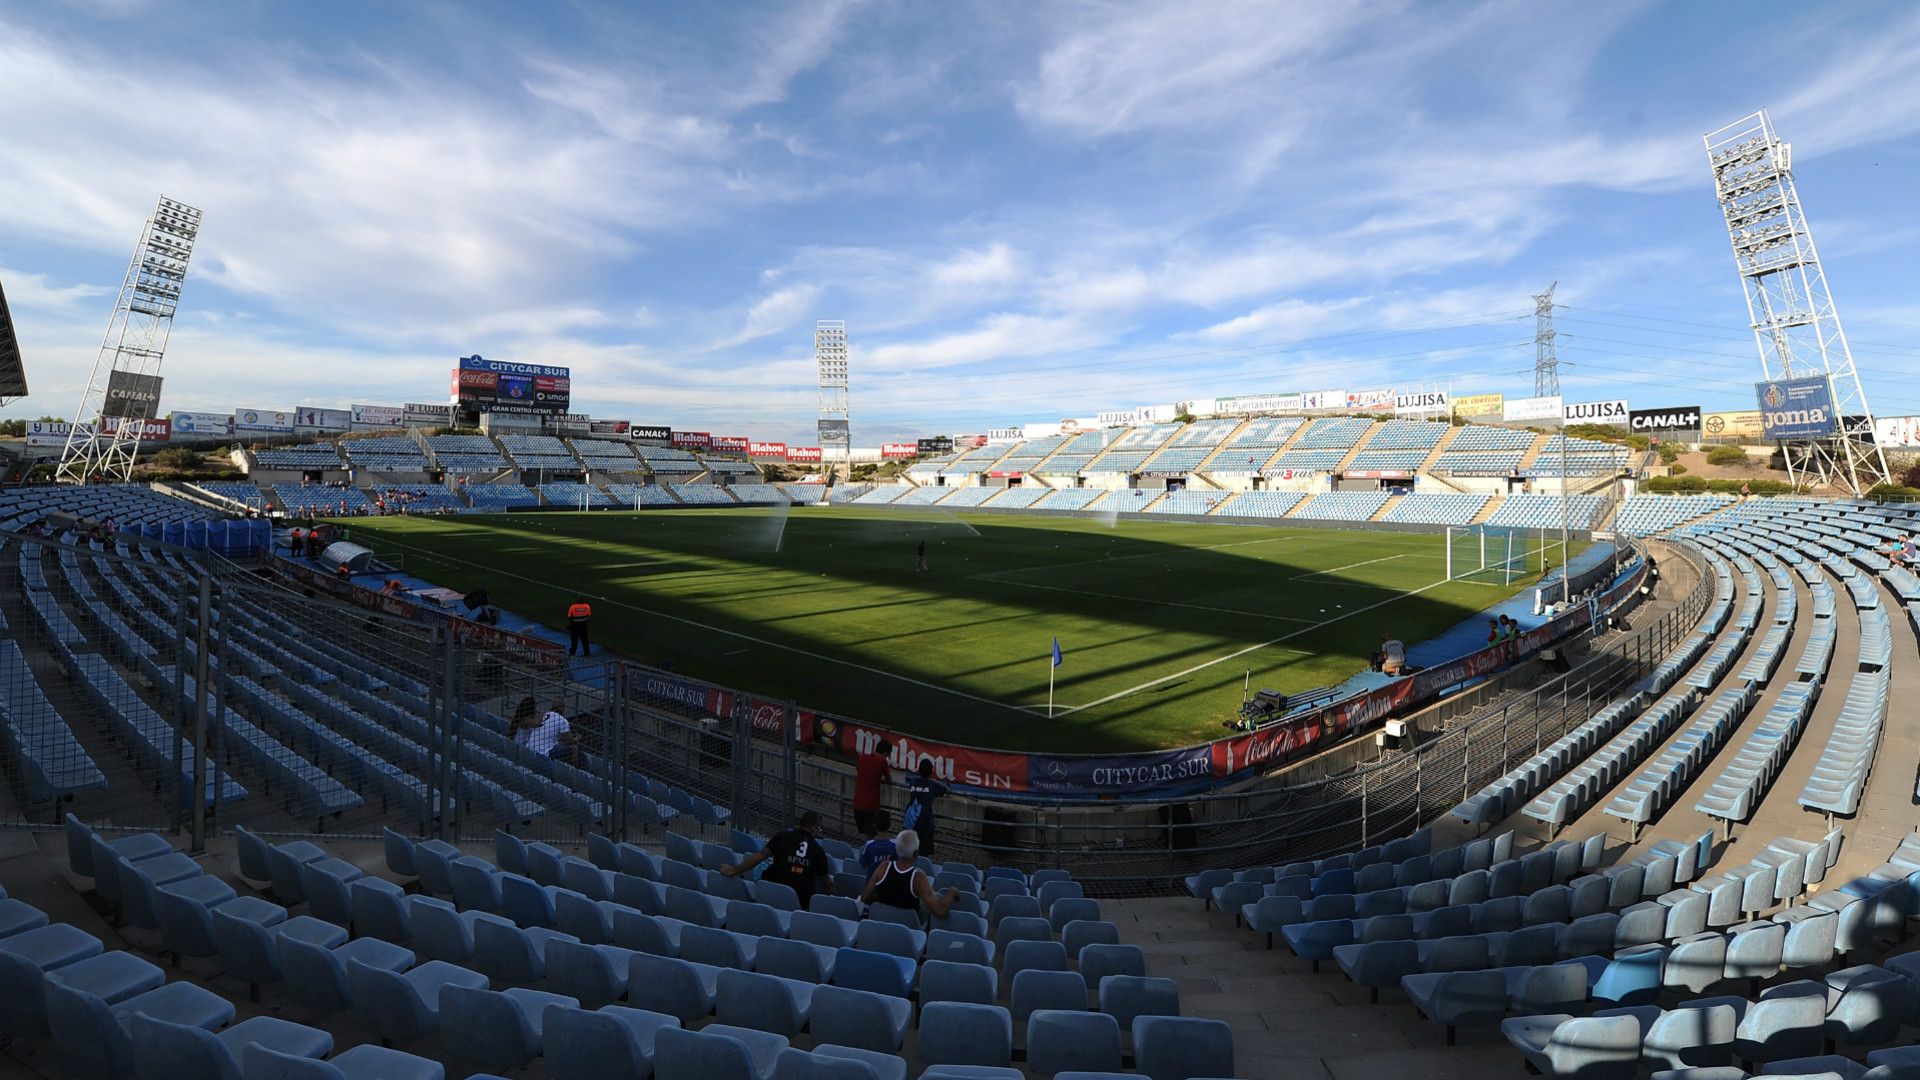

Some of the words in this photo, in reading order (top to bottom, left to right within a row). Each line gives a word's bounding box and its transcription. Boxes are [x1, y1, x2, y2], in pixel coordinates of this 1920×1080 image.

[490, 362, 541, 374] CITYCAR
[544, 368, 567, 377] SUR
[460, 371, 495, 385] Coca-Cola
[110, 388, 157, 402] CANAL+
[546, 392, 570, 401] smart
[1397, 393, 1446, 408] LUJISA
[418, 404, 450, 413] LUJISA
[510, 406, 532, 414] CENTRO
[533, 407, 552, 415] GETAFE
[1565, 402, 1627, 419] LUJISA
[1100, 412, 1135, 423] LUJISA
[1631, 412, 1699, 429] CANAL+
[632, 429, 668, 438] CANAL+
[673, 432, 709, 442] Mahou
[990, 429, 1024, 440] LUJISA
[712, 437, 747, 447] Mahou
[750, 443, 784, 453] Mahou
[787, 448, 821, 458] Mahou
[883, 444, 916, 454] Mahou
[1566, 469, 1597, 477] OCASO
[647, 679, 685, 702] CITYCAR
[686, 688, 705, 707] SUR
[1244, 728, 1295, 767] Coca-Cola
[1092, 763, 1174, 786] CITYCAR
[1177, 756, 1210, 779] SUR
[965, 769, 1011, 789] SIN
[796, 841, 808, 858] 3
